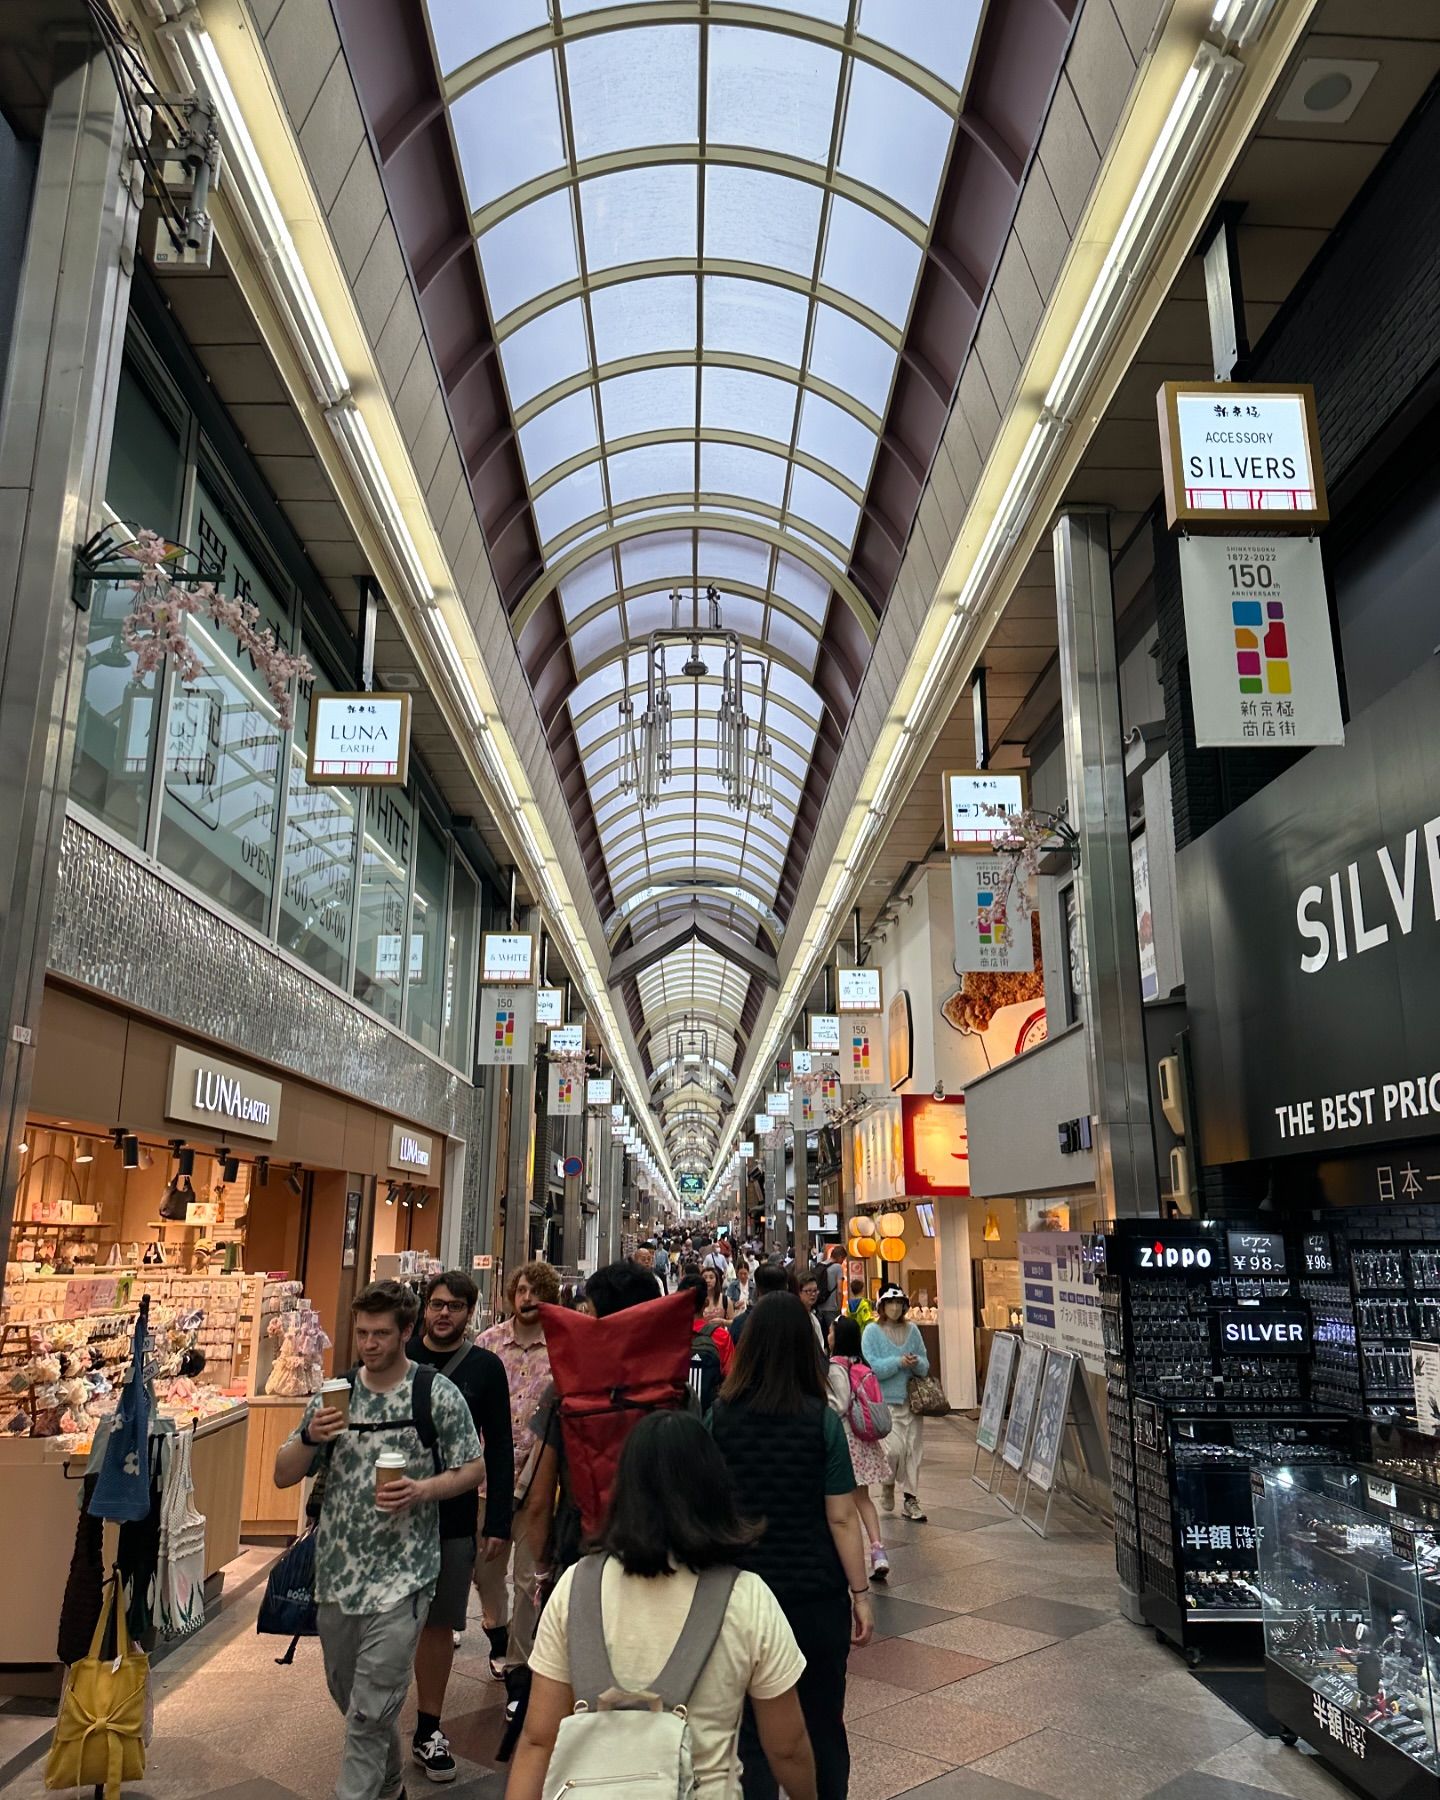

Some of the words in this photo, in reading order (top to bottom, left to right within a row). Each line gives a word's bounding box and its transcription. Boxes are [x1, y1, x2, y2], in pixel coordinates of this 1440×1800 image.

[1206, 432, 1273, 443] ACCESSORY
[1190, 456, 1296, 479] SILVERS
[1240, 700, 1295, 717] 新京極
[330, 725, 388, 740] LUNA
[1242, 720, 1296, 737] 商店街
[340, 744, 375, 753] EARTH
[253, 791, 276, 836] TEL
[241, 834, 274, 882] OPEN
[499, 953, 528, 962] WHITE
[497, 998, 512, 1008] 150
[852, 1025, 866, 1035] 150
[194, 1068, 242, 1119] LUNA
[242, 1100, 270, 1126] EARTH
[1275, 1101, 1315, 1138] THE
[1321, 1088, 1375, 1132] BEST
[399, 1136, 418, 1164] LUNA
[1241, 1237, 1272, 1247] ピアス
[1226, 1323, 1303, 1341] SILVER
[1186, 1525, 1232, 1550] 半額
[1313, 1692, 1344, 1744] 半額
